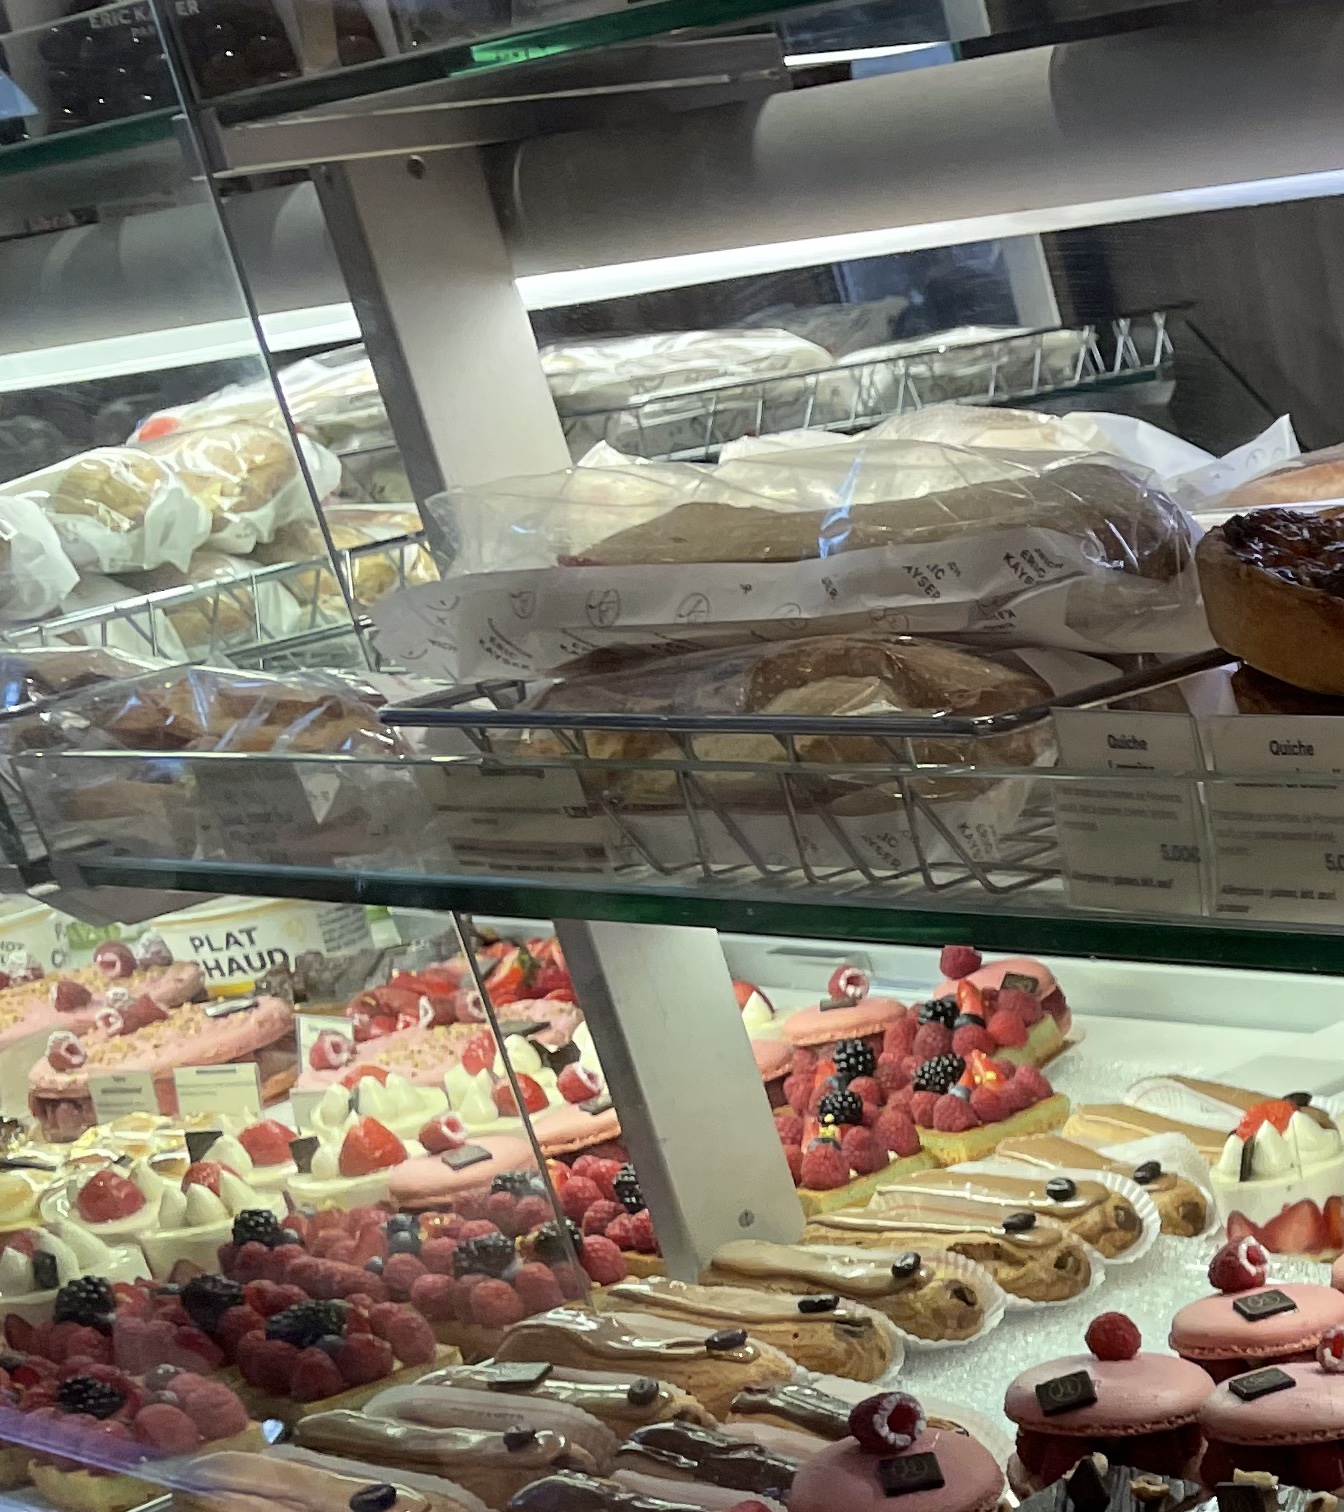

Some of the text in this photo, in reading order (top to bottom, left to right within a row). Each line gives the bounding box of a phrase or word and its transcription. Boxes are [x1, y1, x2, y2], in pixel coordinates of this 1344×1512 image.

[1106, 733, 1148, 752] Quiche
[1269, 739, 1315, 758] Quiche
[189, 926, 259, 954] PLAT
[198, 947, 291, 979] HAUD
